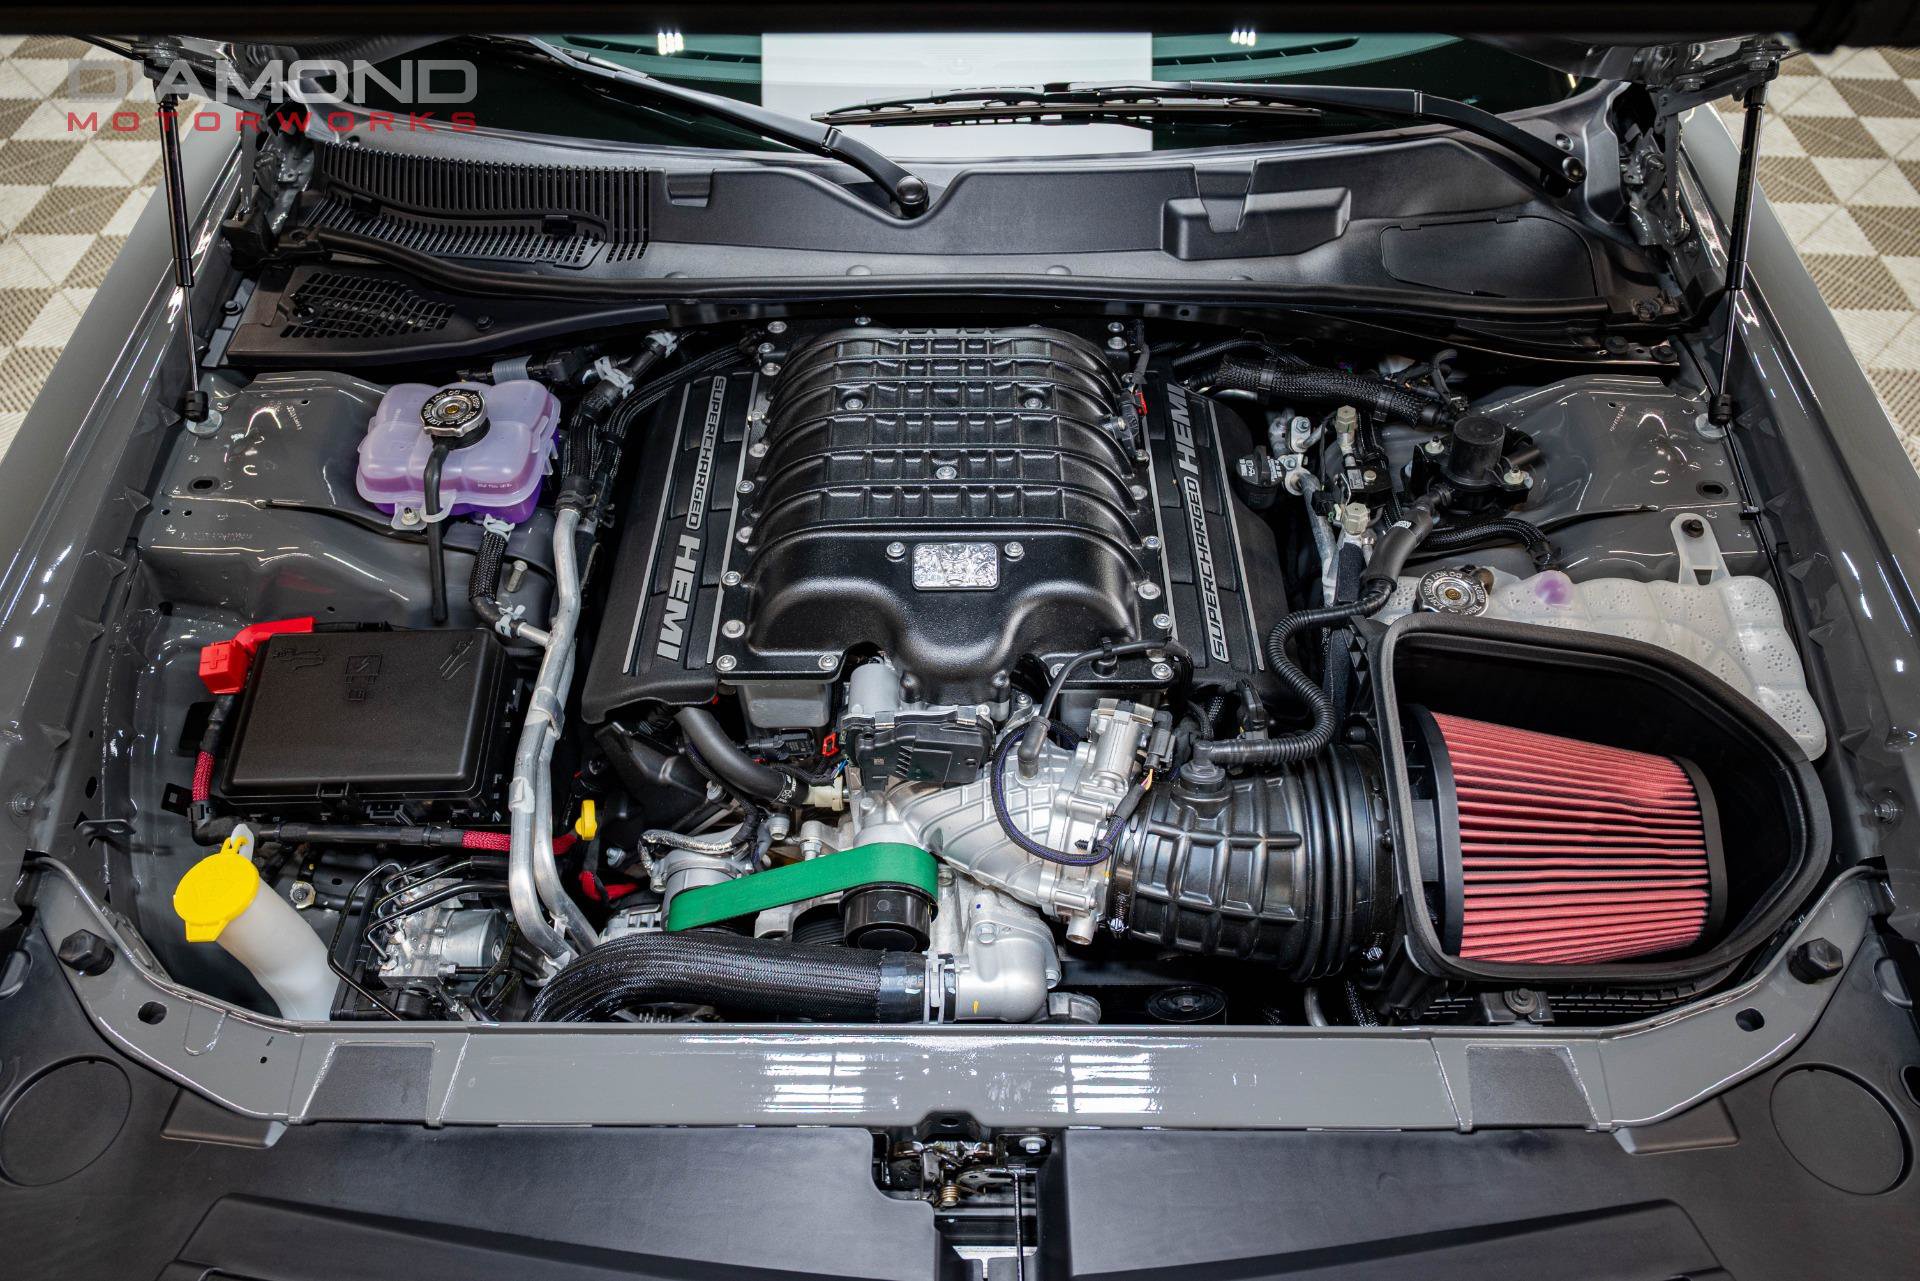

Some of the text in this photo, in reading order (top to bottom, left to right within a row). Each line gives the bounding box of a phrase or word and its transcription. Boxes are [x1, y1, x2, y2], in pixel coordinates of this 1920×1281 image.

[656, 376, 727, 661] SUPERCHARGED HEMI
[1166, 384, 1230, 663] SUPERCHARGED HEMI
[1472, 585, 1485, 603] KEEP
